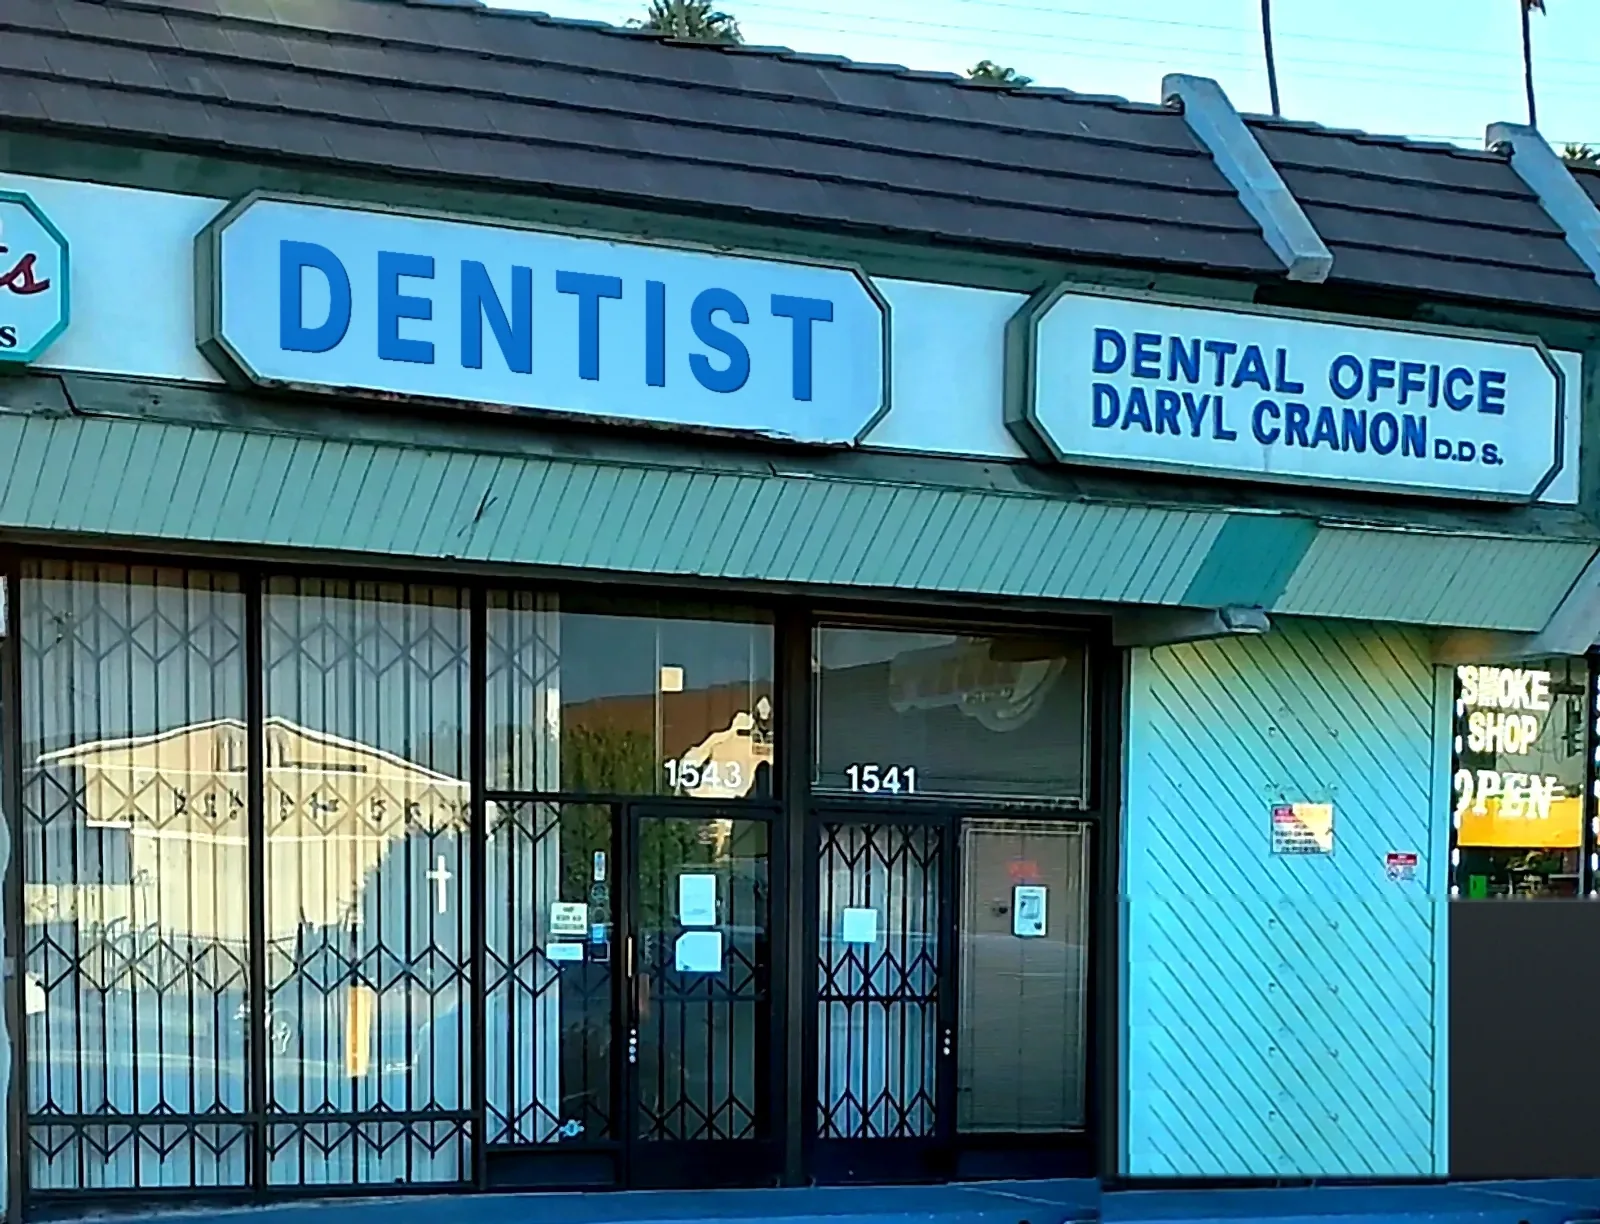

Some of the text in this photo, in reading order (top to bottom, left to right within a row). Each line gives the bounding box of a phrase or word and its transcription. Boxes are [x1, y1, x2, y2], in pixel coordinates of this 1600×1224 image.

[280, 240, 834, 402] DENTIST
[1093, 327, 1507, 416] DENTAL OFFICE
[1092, 382, 1238, 442] DARYL
[1252, 398, 1427, 459] CRANON
[1458, 665, 1551, 711] SMOKE
[1467, 711, 1538, 755] SHOP
[664, 759, 742, 788] 1543
[846, 764, 917, 794] 1541
